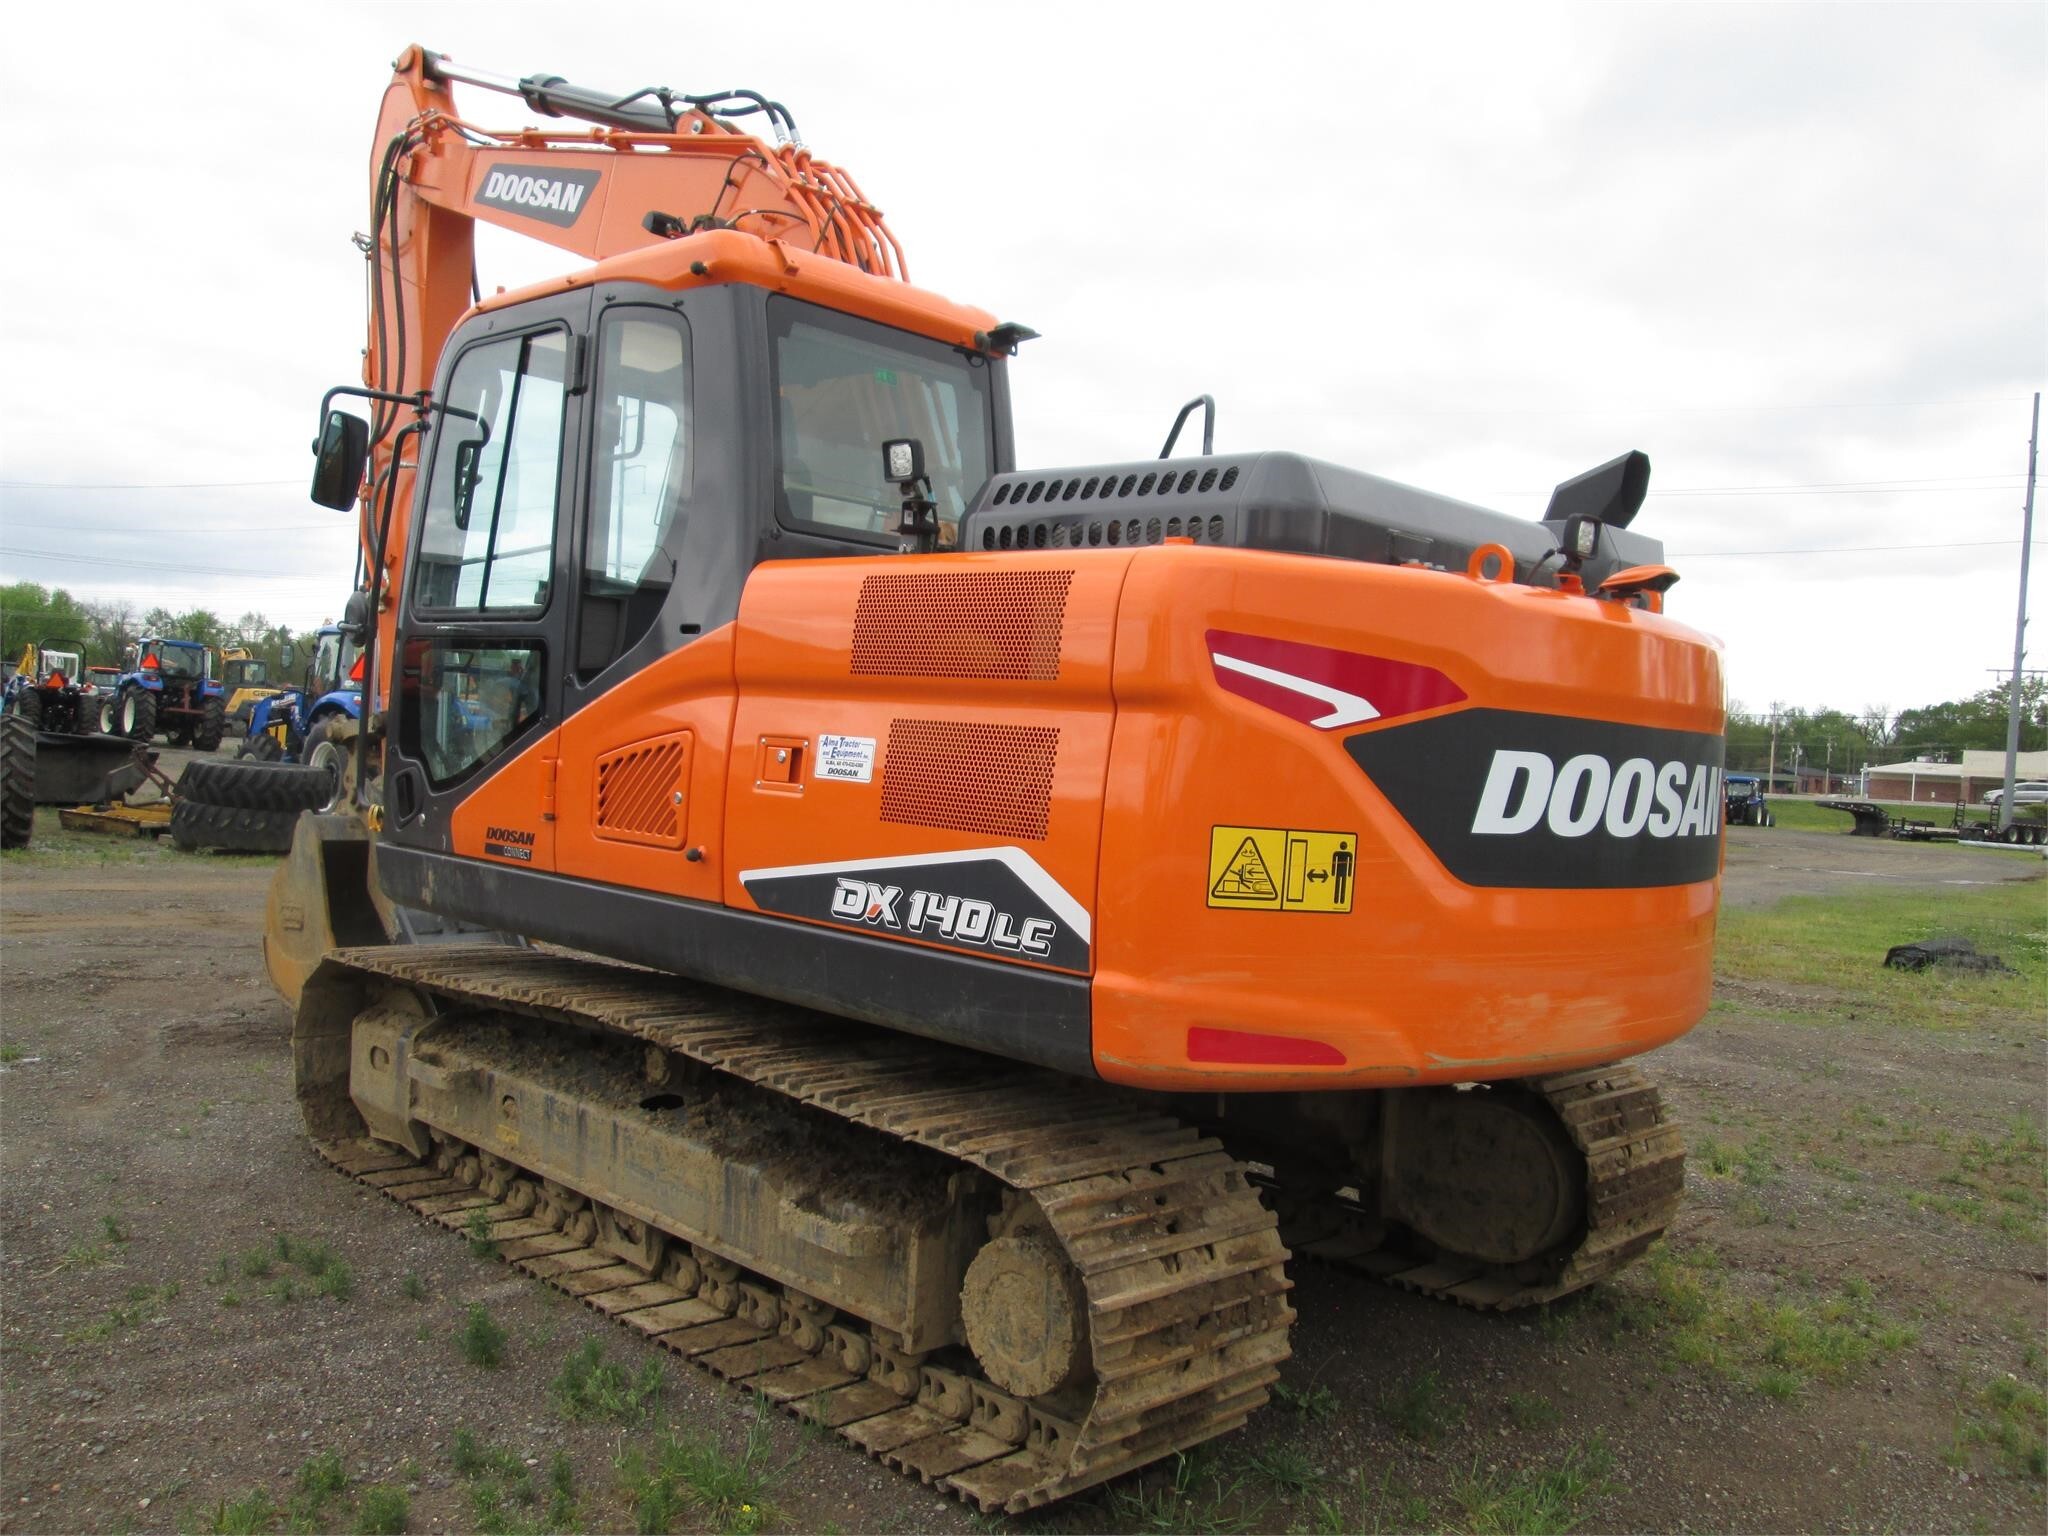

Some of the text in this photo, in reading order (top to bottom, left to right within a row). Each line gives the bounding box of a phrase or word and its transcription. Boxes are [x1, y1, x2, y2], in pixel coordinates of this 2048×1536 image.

[485, 172, 584, 212] DOOSAN
[823, 736, 861, 748] Alma Tractor
[831, 747, 863, 758] Equipment
[828, 767, 859, 776] DOOSAN
[1471, 750, 1723, 837] DOOSAN
[486, 826, 535, 846] DOOSAN
[504, 846, 530, 860] CONNECT
[831, 878, 903, 929] DX
